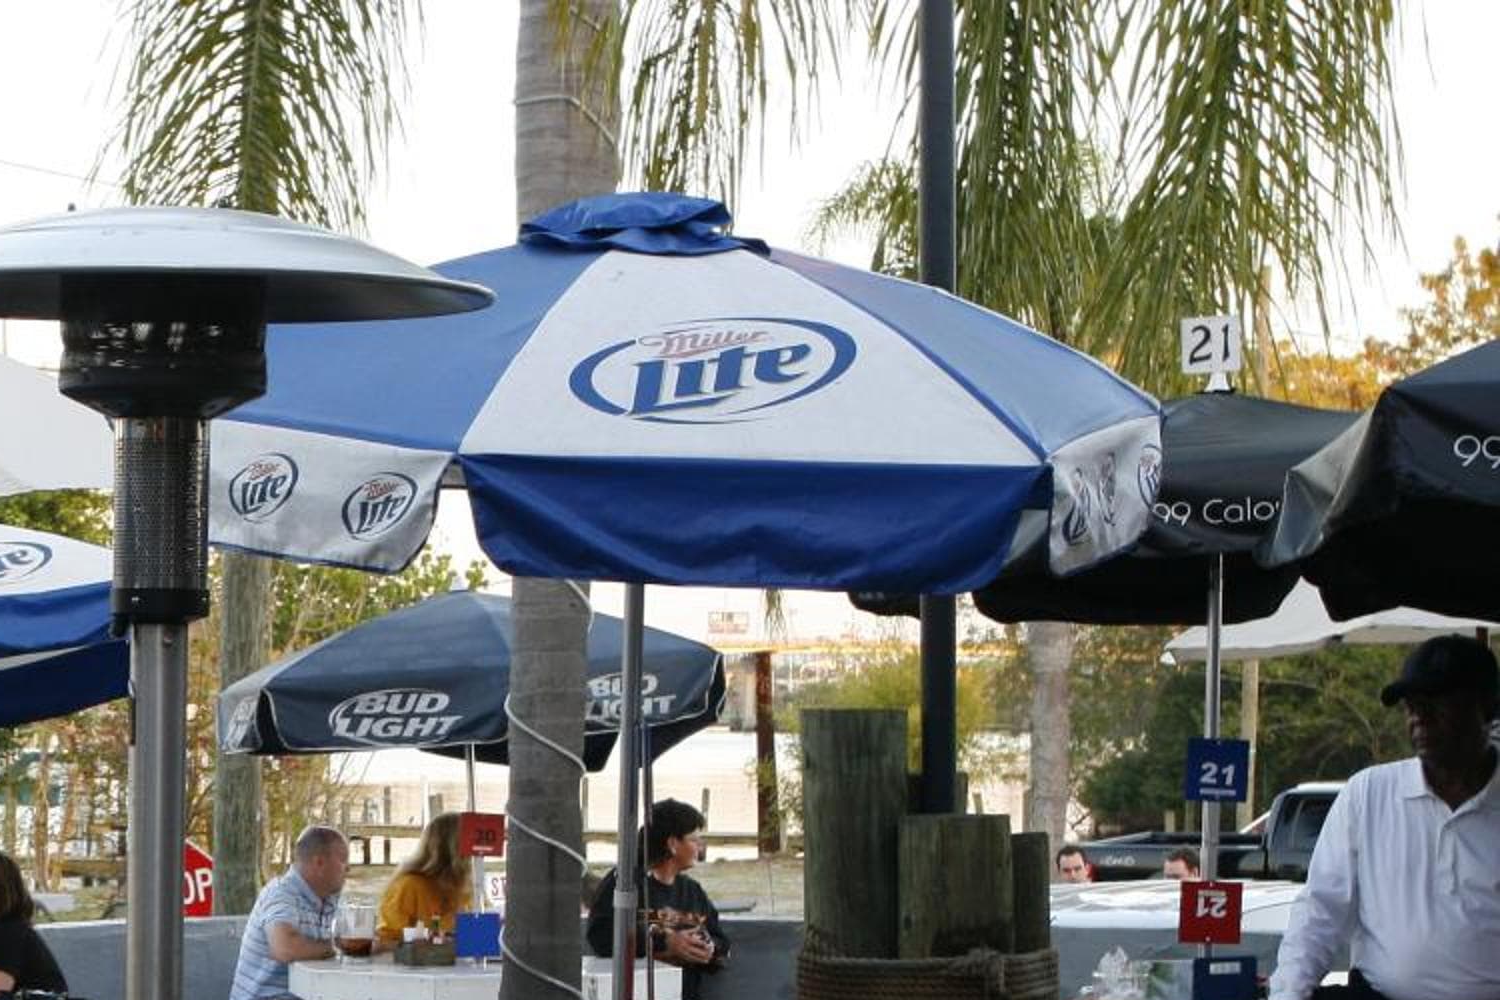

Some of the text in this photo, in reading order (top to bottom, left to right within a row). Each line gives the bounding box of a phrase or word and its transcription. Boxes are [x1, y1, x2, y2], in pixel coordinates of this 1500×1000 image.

[638, 329, 775, 358] Miller
[1189, 324, 1230, 365] 21
[627, 343, 812, 415] Lite
[239, 474, 287, 515] Lite
[352, 494, 406, 535] Lite
[1152, 502, 1191, 526] 99
[353, 693, 450, 715] BUD
[332, 715, 464, 737] LIGHT
[1200, 762, 1235, 785] 21
[1196, 893, 1227, 918] 21
